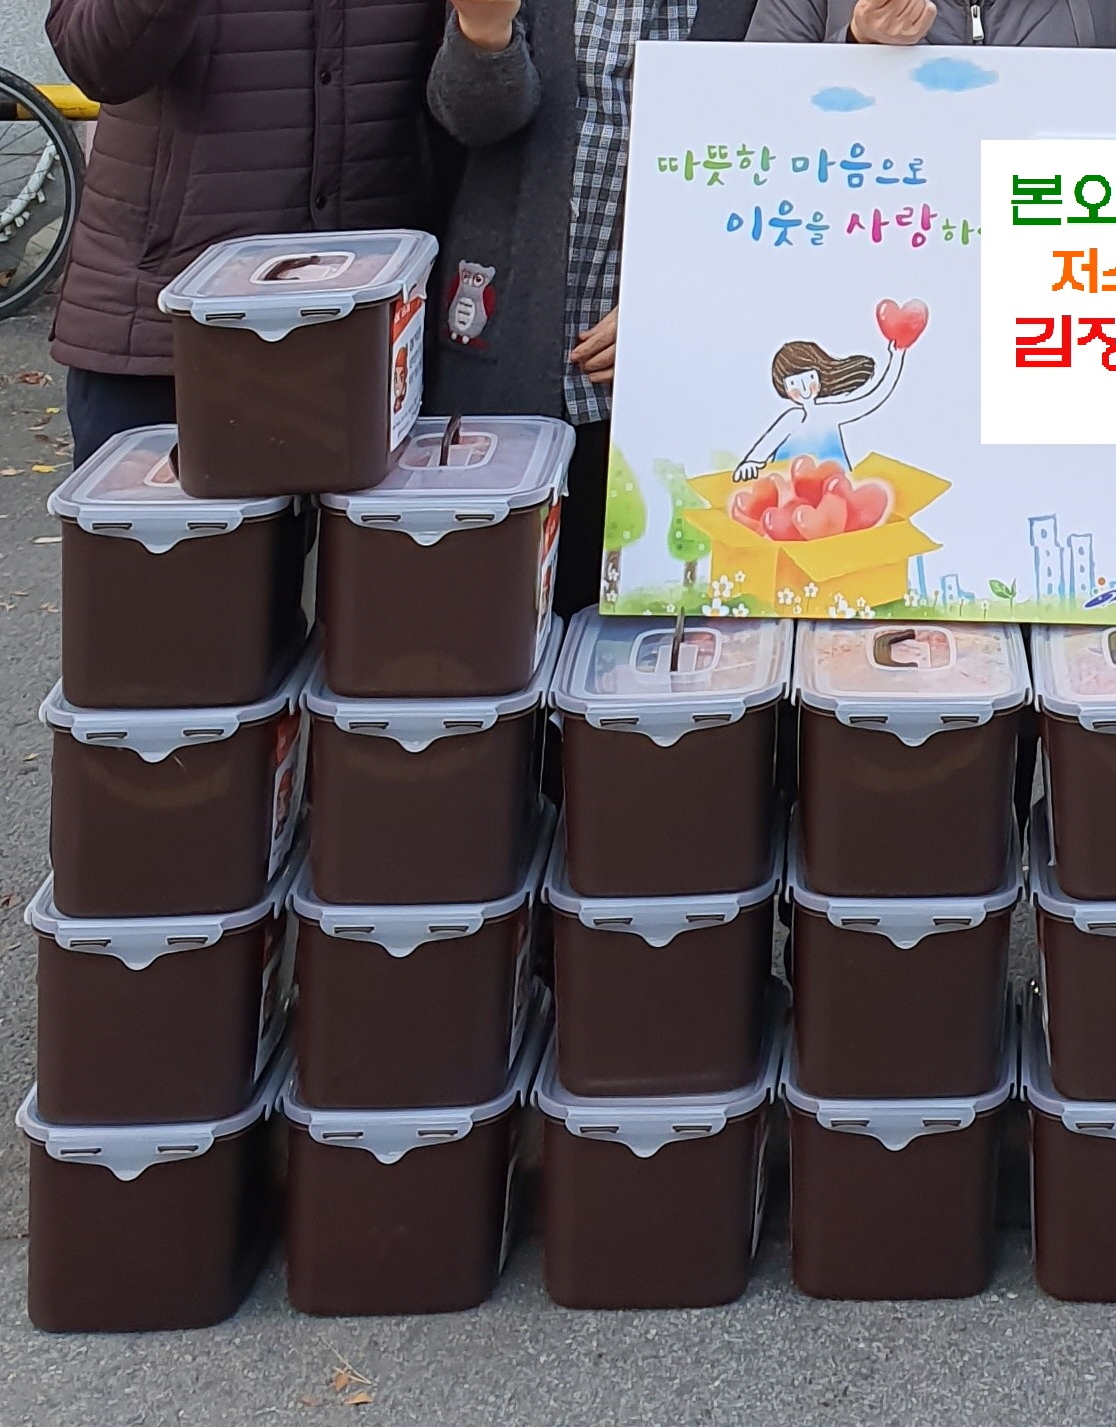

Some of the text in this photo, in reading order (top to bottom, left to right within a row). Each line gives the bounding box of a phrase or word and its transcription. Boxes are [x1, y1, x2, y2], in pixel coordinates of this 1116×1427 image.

[657, 142, 928, 189] 따뜻한 마음으로
[726, 200, 981, 248] 이웃을 사랑하
